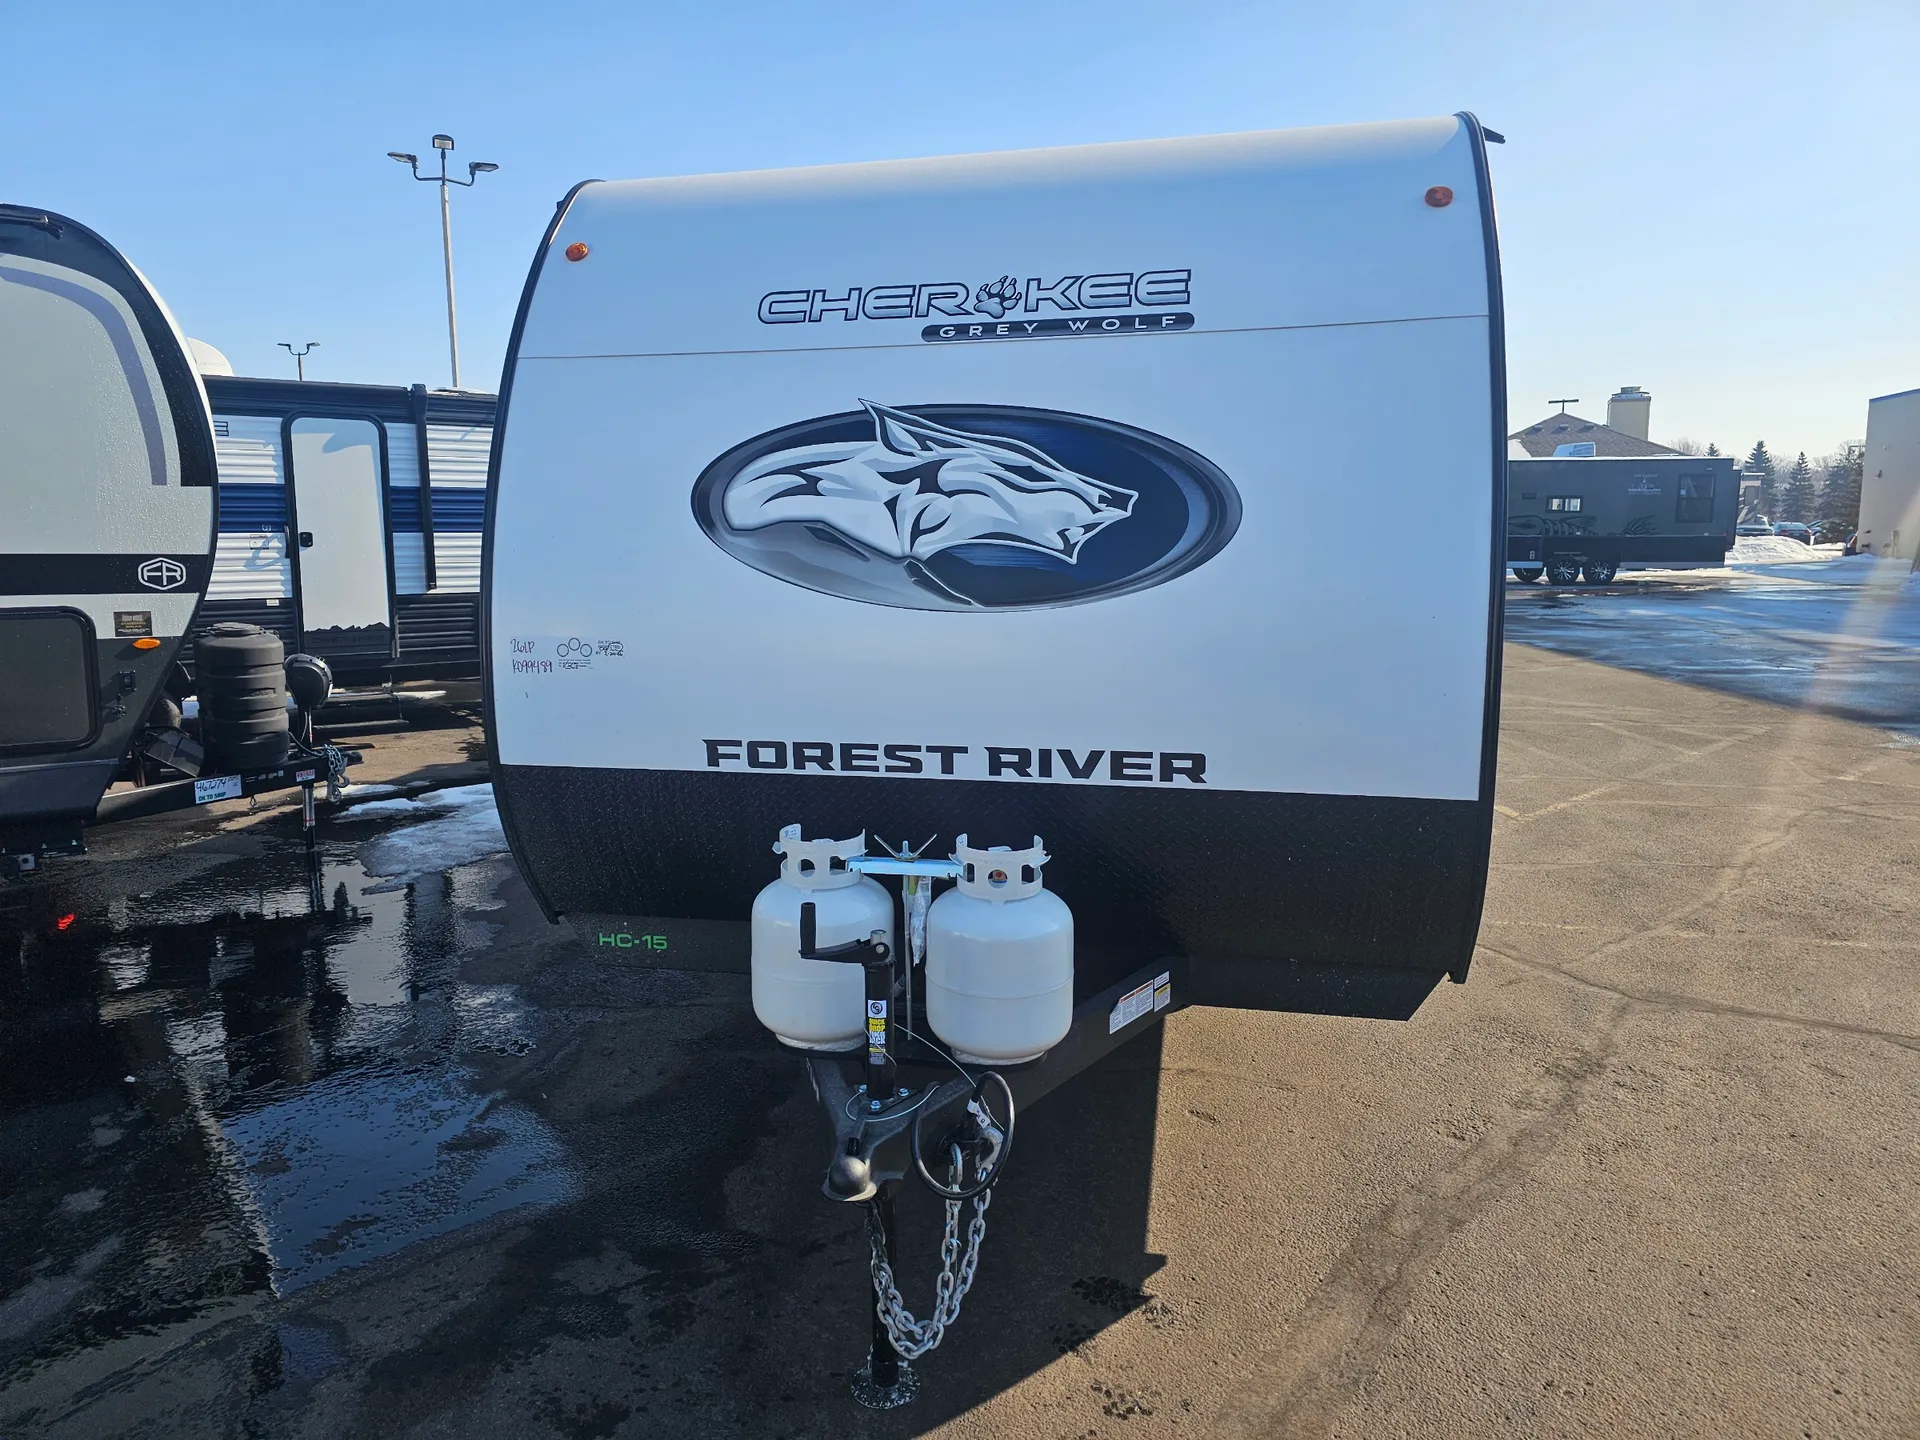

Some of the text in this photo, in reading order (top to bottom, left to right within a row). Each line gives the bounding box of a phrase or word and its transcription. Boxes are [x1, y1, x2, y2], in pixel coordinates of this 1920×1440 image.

[758, 269, 1191, 323] CHEROKEE
[938, 314, 1178, 338] GREY WOLF
[702, 738, 1207, 784] FOREST RIVER
[598, 933, 668, 950] HC-15
